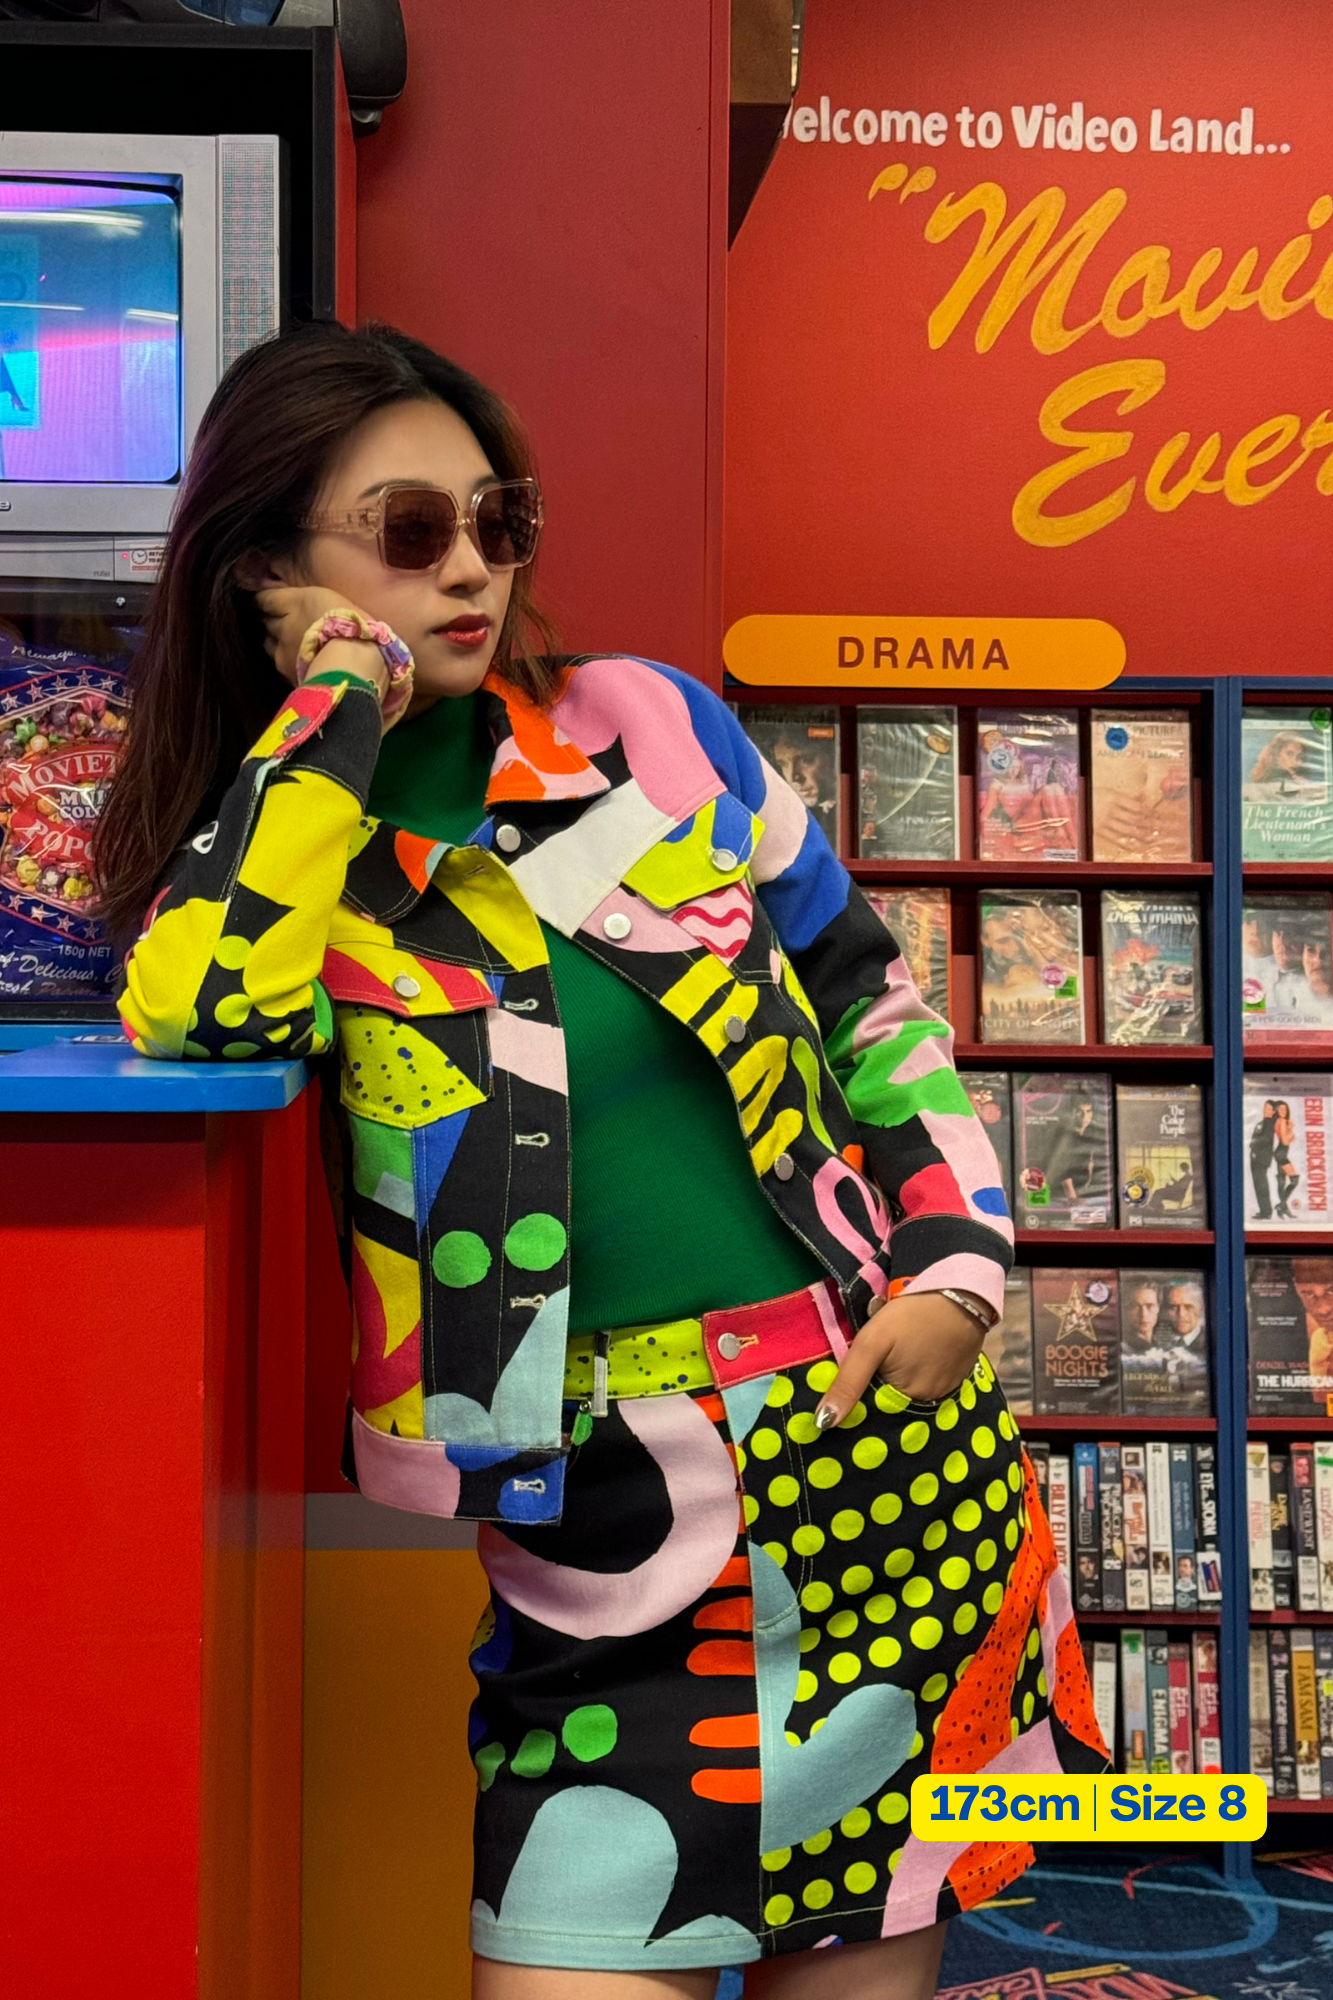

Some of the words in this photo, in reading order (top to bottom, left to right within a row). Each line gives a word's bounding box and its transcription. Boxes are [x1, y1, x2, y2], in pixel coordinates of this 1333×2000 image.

[782, 95, 947, 146] elcome
[955, 105, 1003, 149] to
[1011, 102, 1138, 152] Video
[1149, 107, 1291, 155] Land...
[837, 636, 1010, 670] DRAMA
[1246, 805, 1272, 818] The
[1276, 805, 1325, 819] French
[1260, 830, 1312, 843] Woman
[59, 944, 86, 959] 150g
[88, 946, 112, 958] NET
[1168, 1104, 1186, 1116] The
[1304, 1097, 1325, 1127] ERIN
[1160, 1124, 1187, 1138] Purple
[1305, 1130, 1328, 1212] BROCKOVICH
[1045, 1344, 1109, 1361] BOOGIE
[1045, 1360, 1109, 1378] NIGHTS
[1256, 1374, 1281, 1388] THE
[1050, 1483, 1066, 1518] BILLY
[1201, 1500, 1218, 1537] STORM
[1273, 1669, 1289, 1725] hurricane
[1152, 1688, 1169, 1755] ENIGMA
[1300, 1699, 1314, 1731] SAM
